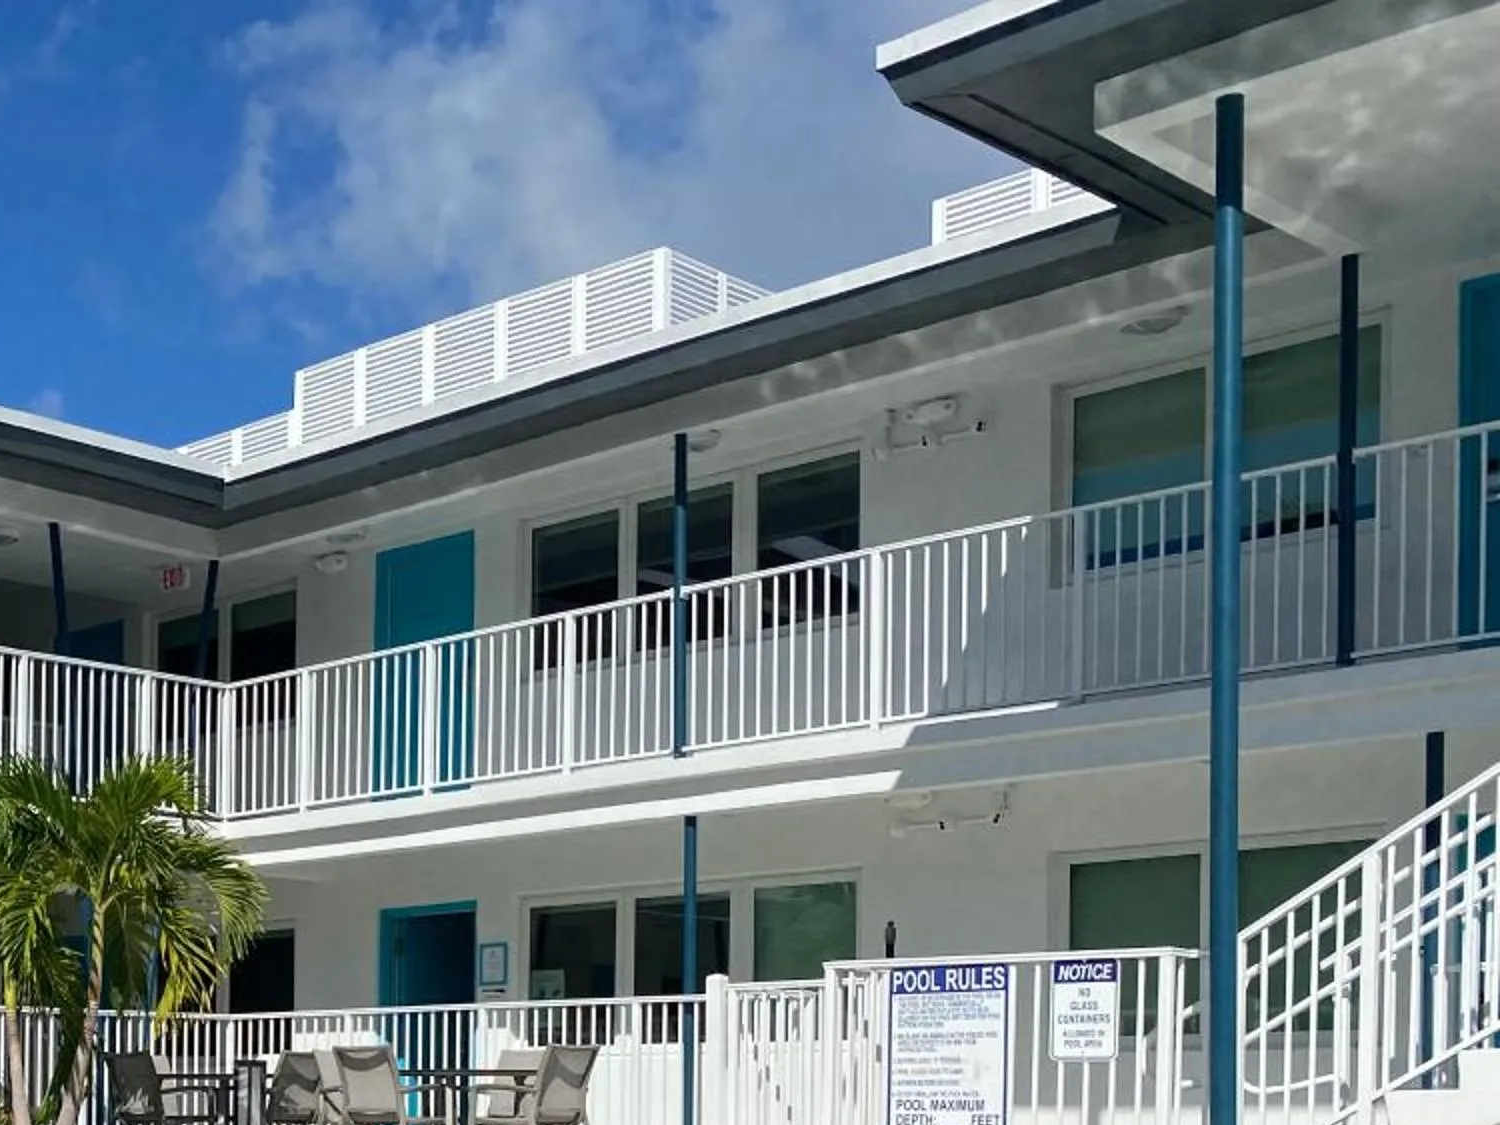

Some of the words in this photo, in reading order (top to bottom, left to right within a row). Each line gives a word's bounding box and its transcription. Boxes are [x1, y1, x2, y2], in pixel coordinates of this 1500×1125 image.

[1057, 963, 1113, 981] NOTICE
[893, 969, 941, 993] POOL
[945, 966, 1005, 990] RULES
[1057, 1013, 1111, 1024] CONTAINERS
[895, 1099, 927, 1111] POOL
[930, 1099, 985, 1112] MAXIMUM
[895, 1113, 937, 1125] DEPTH:
